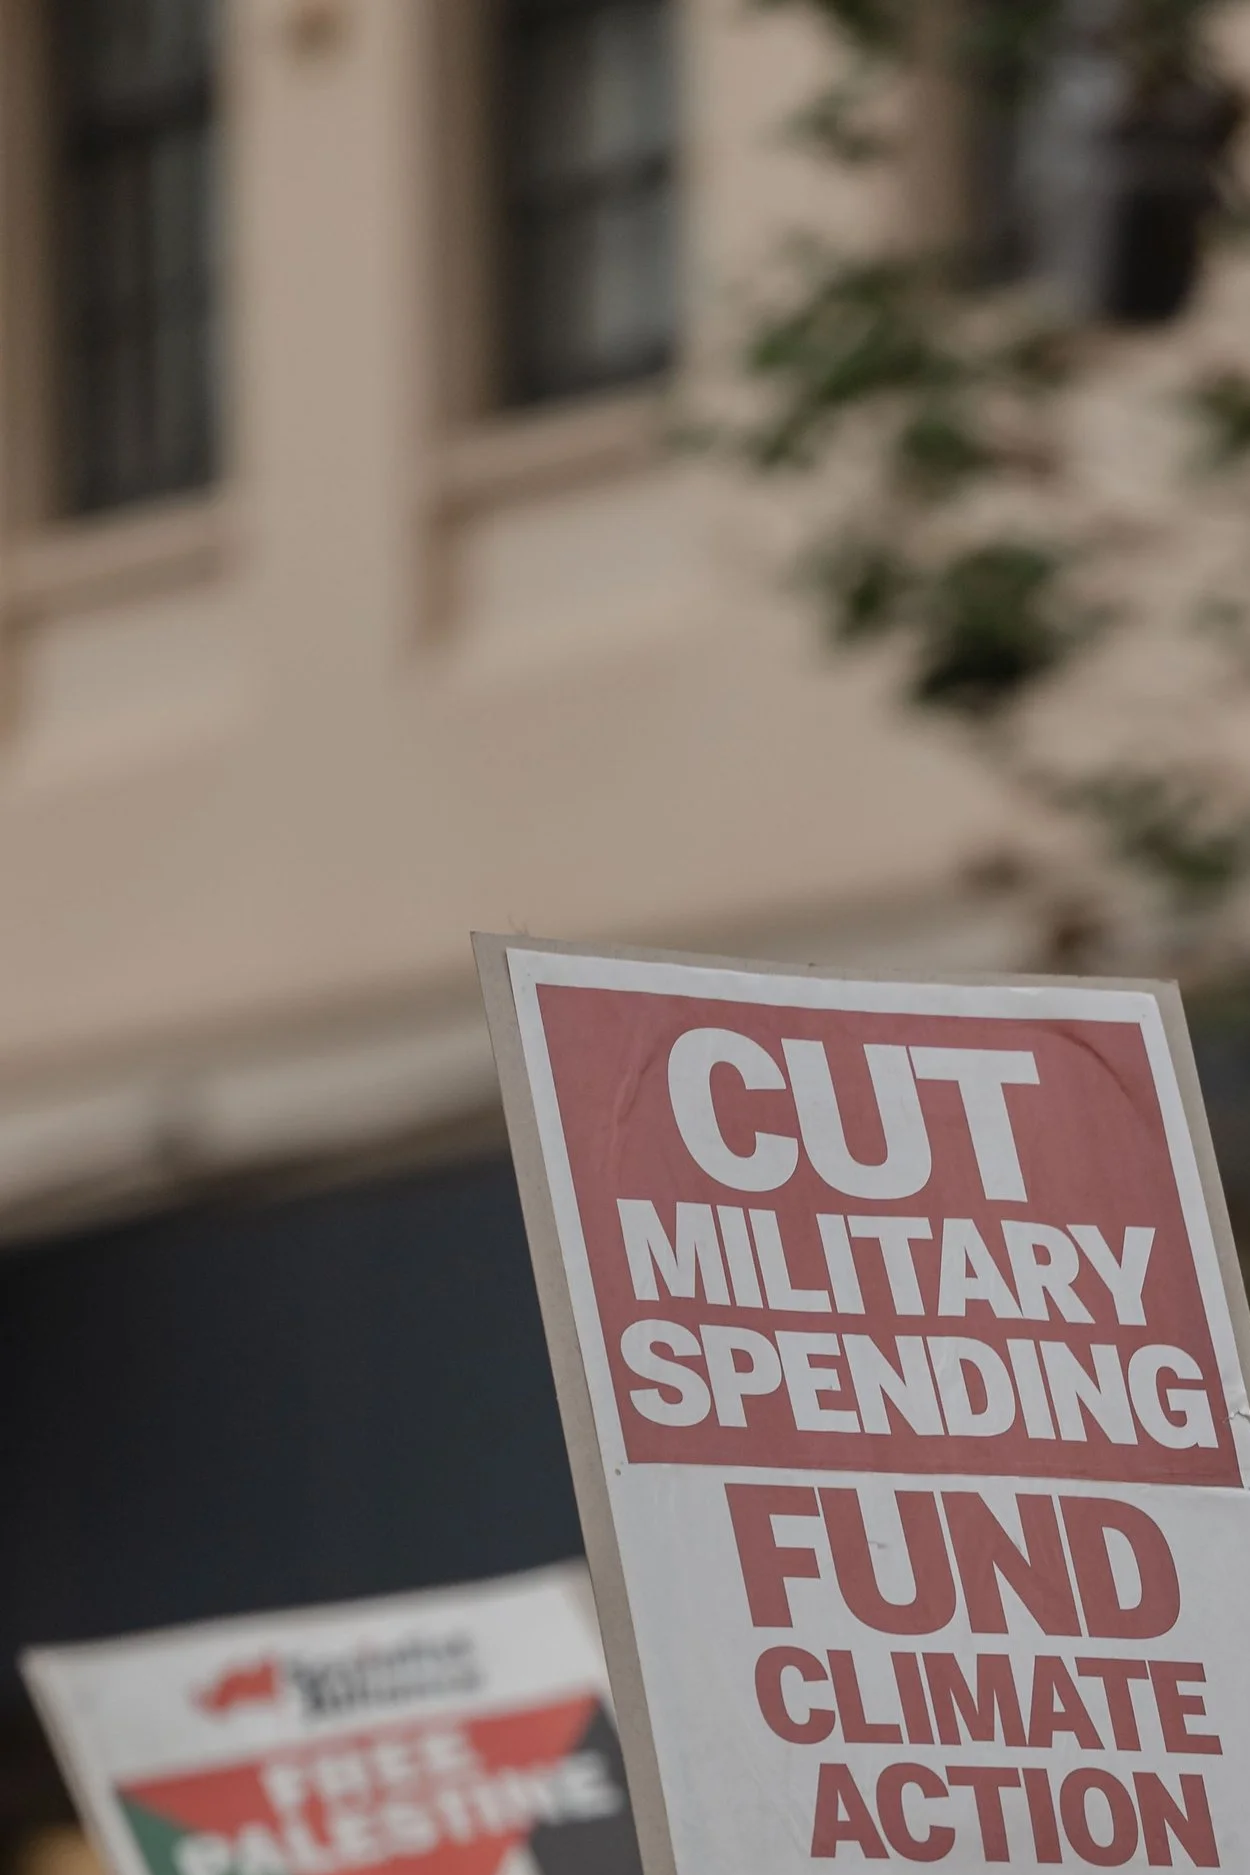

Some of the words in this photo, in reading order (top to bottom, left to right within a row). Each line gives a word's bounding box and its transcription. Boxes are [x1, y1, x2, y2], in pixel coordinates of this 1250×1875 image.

[667, 1027, 1040, 1203] CUT
[616, 1198, 1156, 1326] MILITARY
[620, 1319, 1219, 1450] SPENDING
[724, 1482, 1181, 1640] FUND
[754, 1645, 1223, 1756] CLIMATE
[260, 1726, 478, 1812] FREE
[810, 1762, 1221, 1869] ACTION
